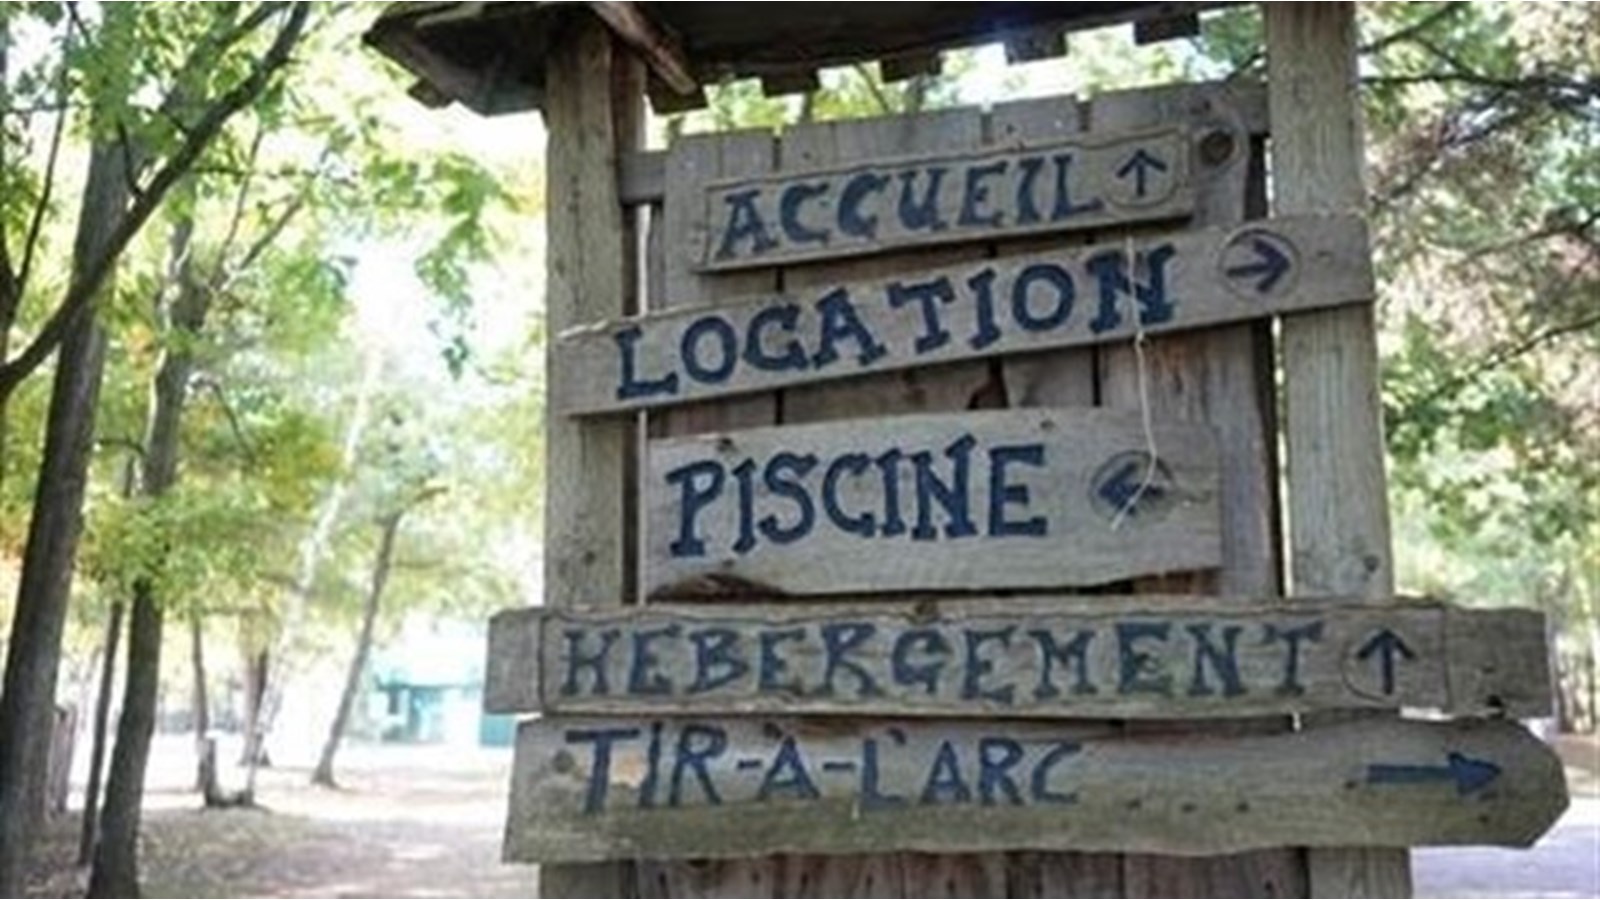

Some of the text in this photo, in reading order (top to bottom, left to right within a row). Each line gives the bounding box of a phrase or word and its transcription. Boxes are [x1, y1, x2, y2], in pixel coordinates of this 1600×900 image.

[717, 153, 1104, 258] ACCUEIL
[615, 243, 1179, 400] LOCATION
[665, 433, 1048, 558] PISCINE
[560, 620, 1324, 704] HEBERGEMENT
